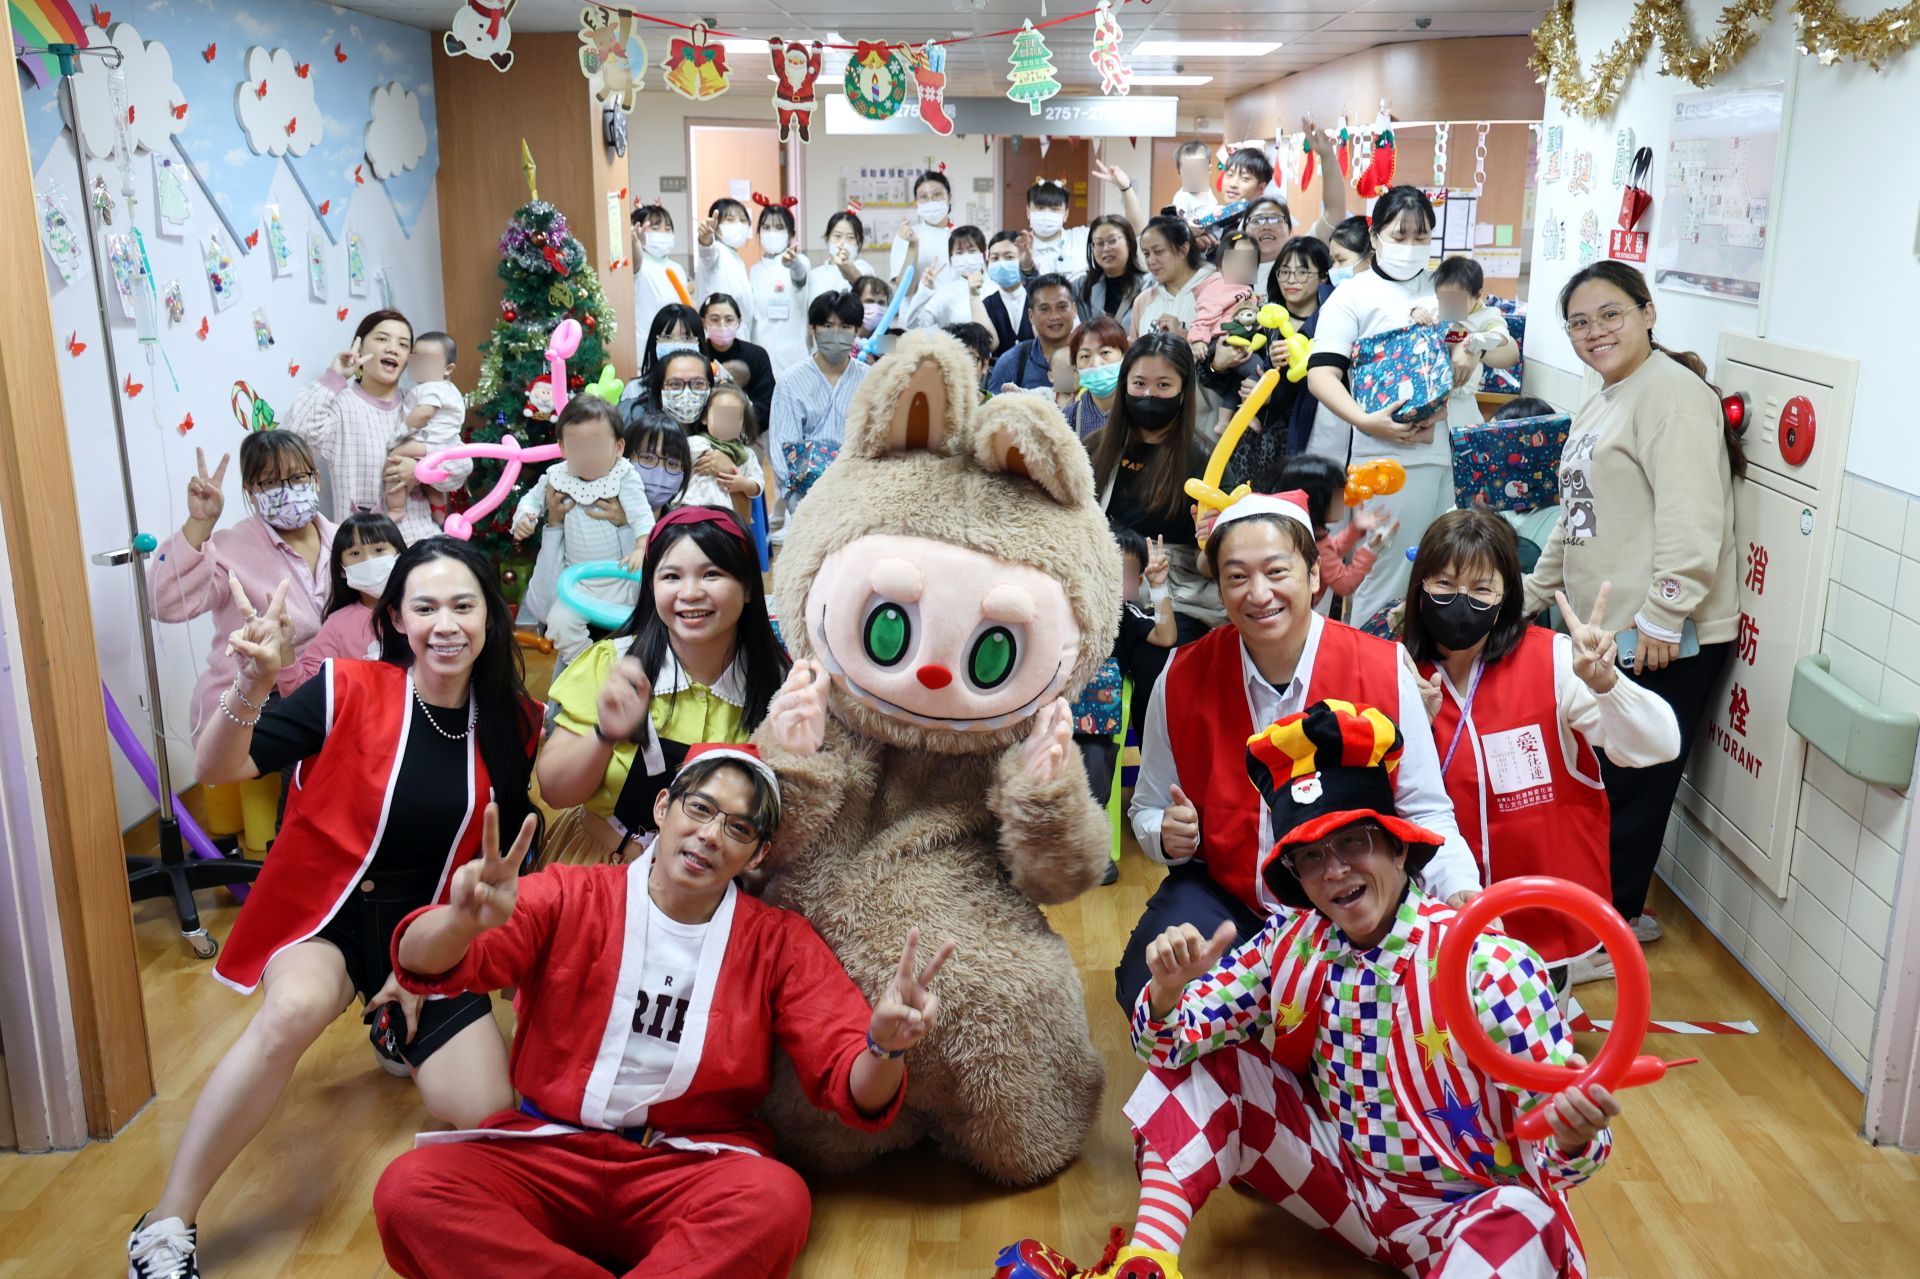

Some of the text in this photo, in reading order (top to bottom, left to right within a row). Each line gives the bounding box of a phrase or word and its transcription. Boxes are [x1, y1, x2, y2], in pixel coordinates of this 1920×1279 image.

[1729, 542, 1768, 737] 消防栓
[1516, 732, 1544, 780] 愛花蓮
[1708, 720, 1762, 779] HYDRANT
[664, 975, 674, 987] R
